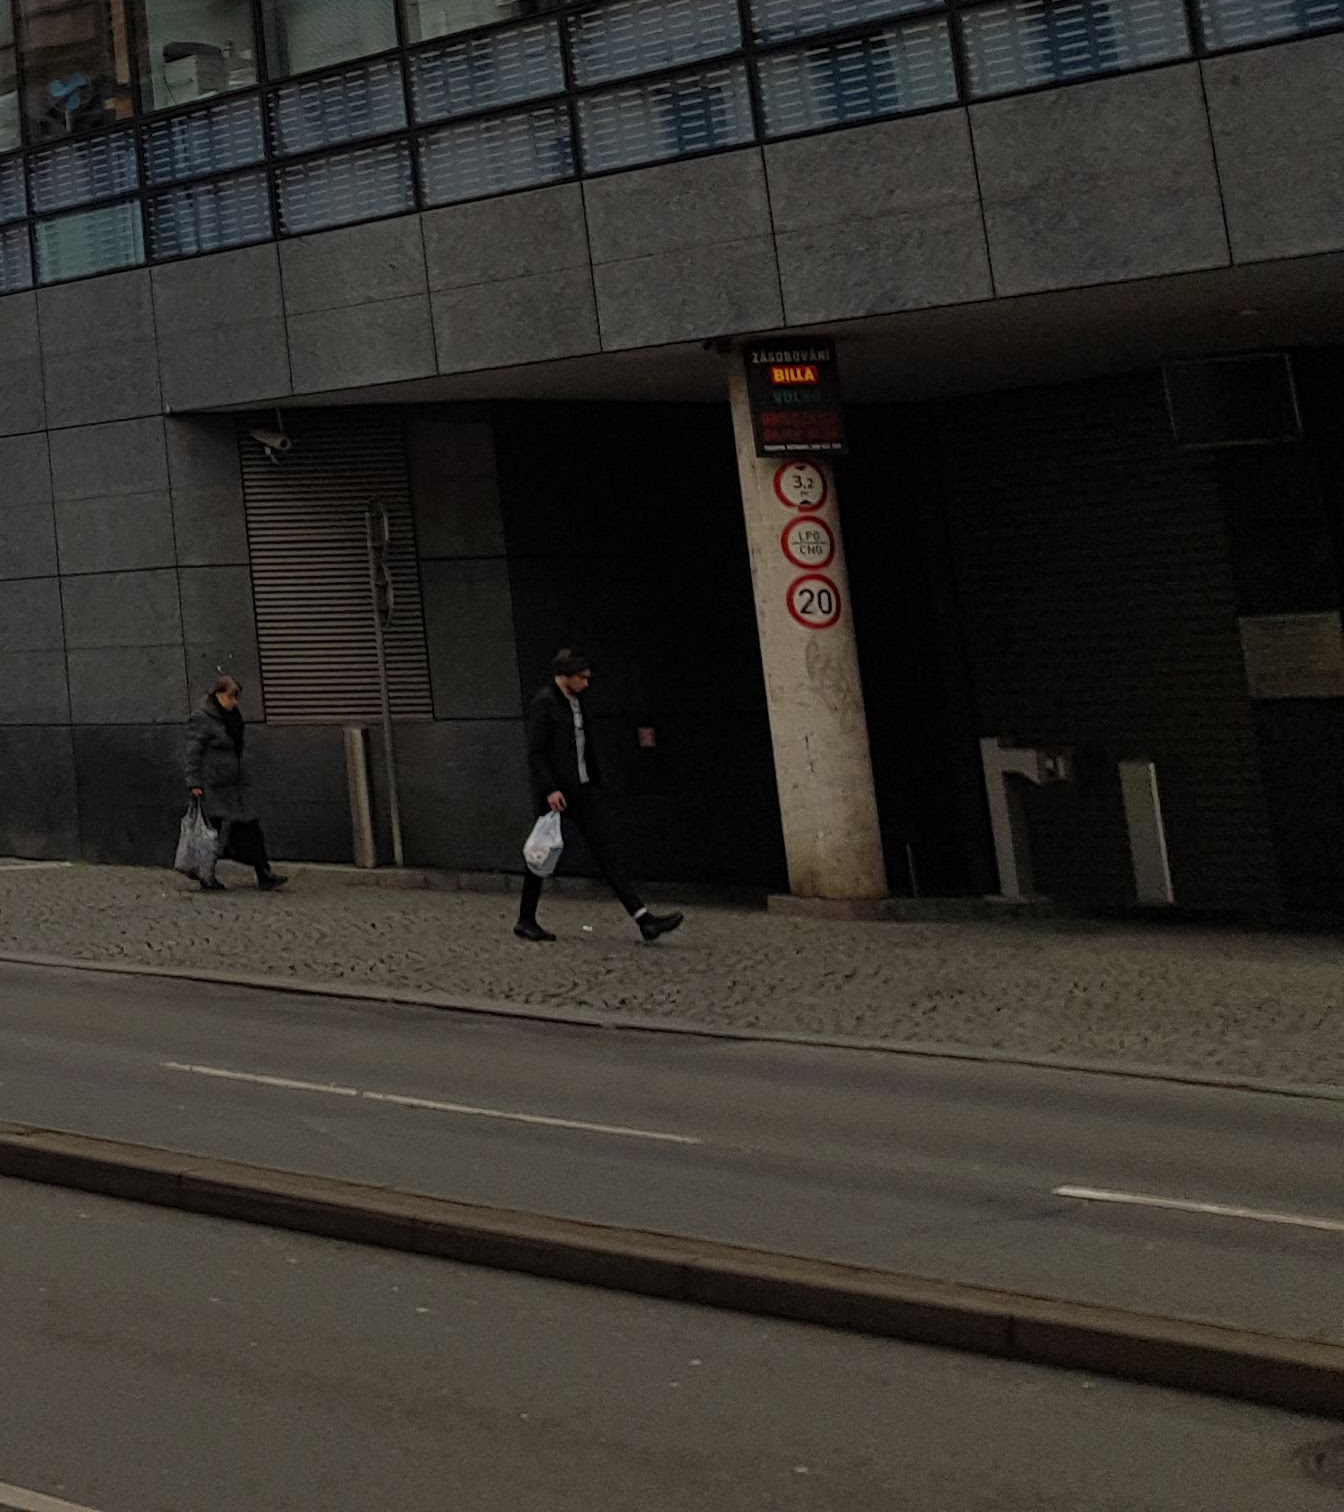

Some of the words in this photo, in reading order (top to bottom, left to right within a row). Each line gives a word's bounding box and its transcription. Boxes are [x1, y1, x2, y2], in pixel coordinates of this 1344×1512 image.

[772, 366, 816, 383] BILLA
[799, 544, 823, 555] CNG
[798, 588, 833, 614] 20
